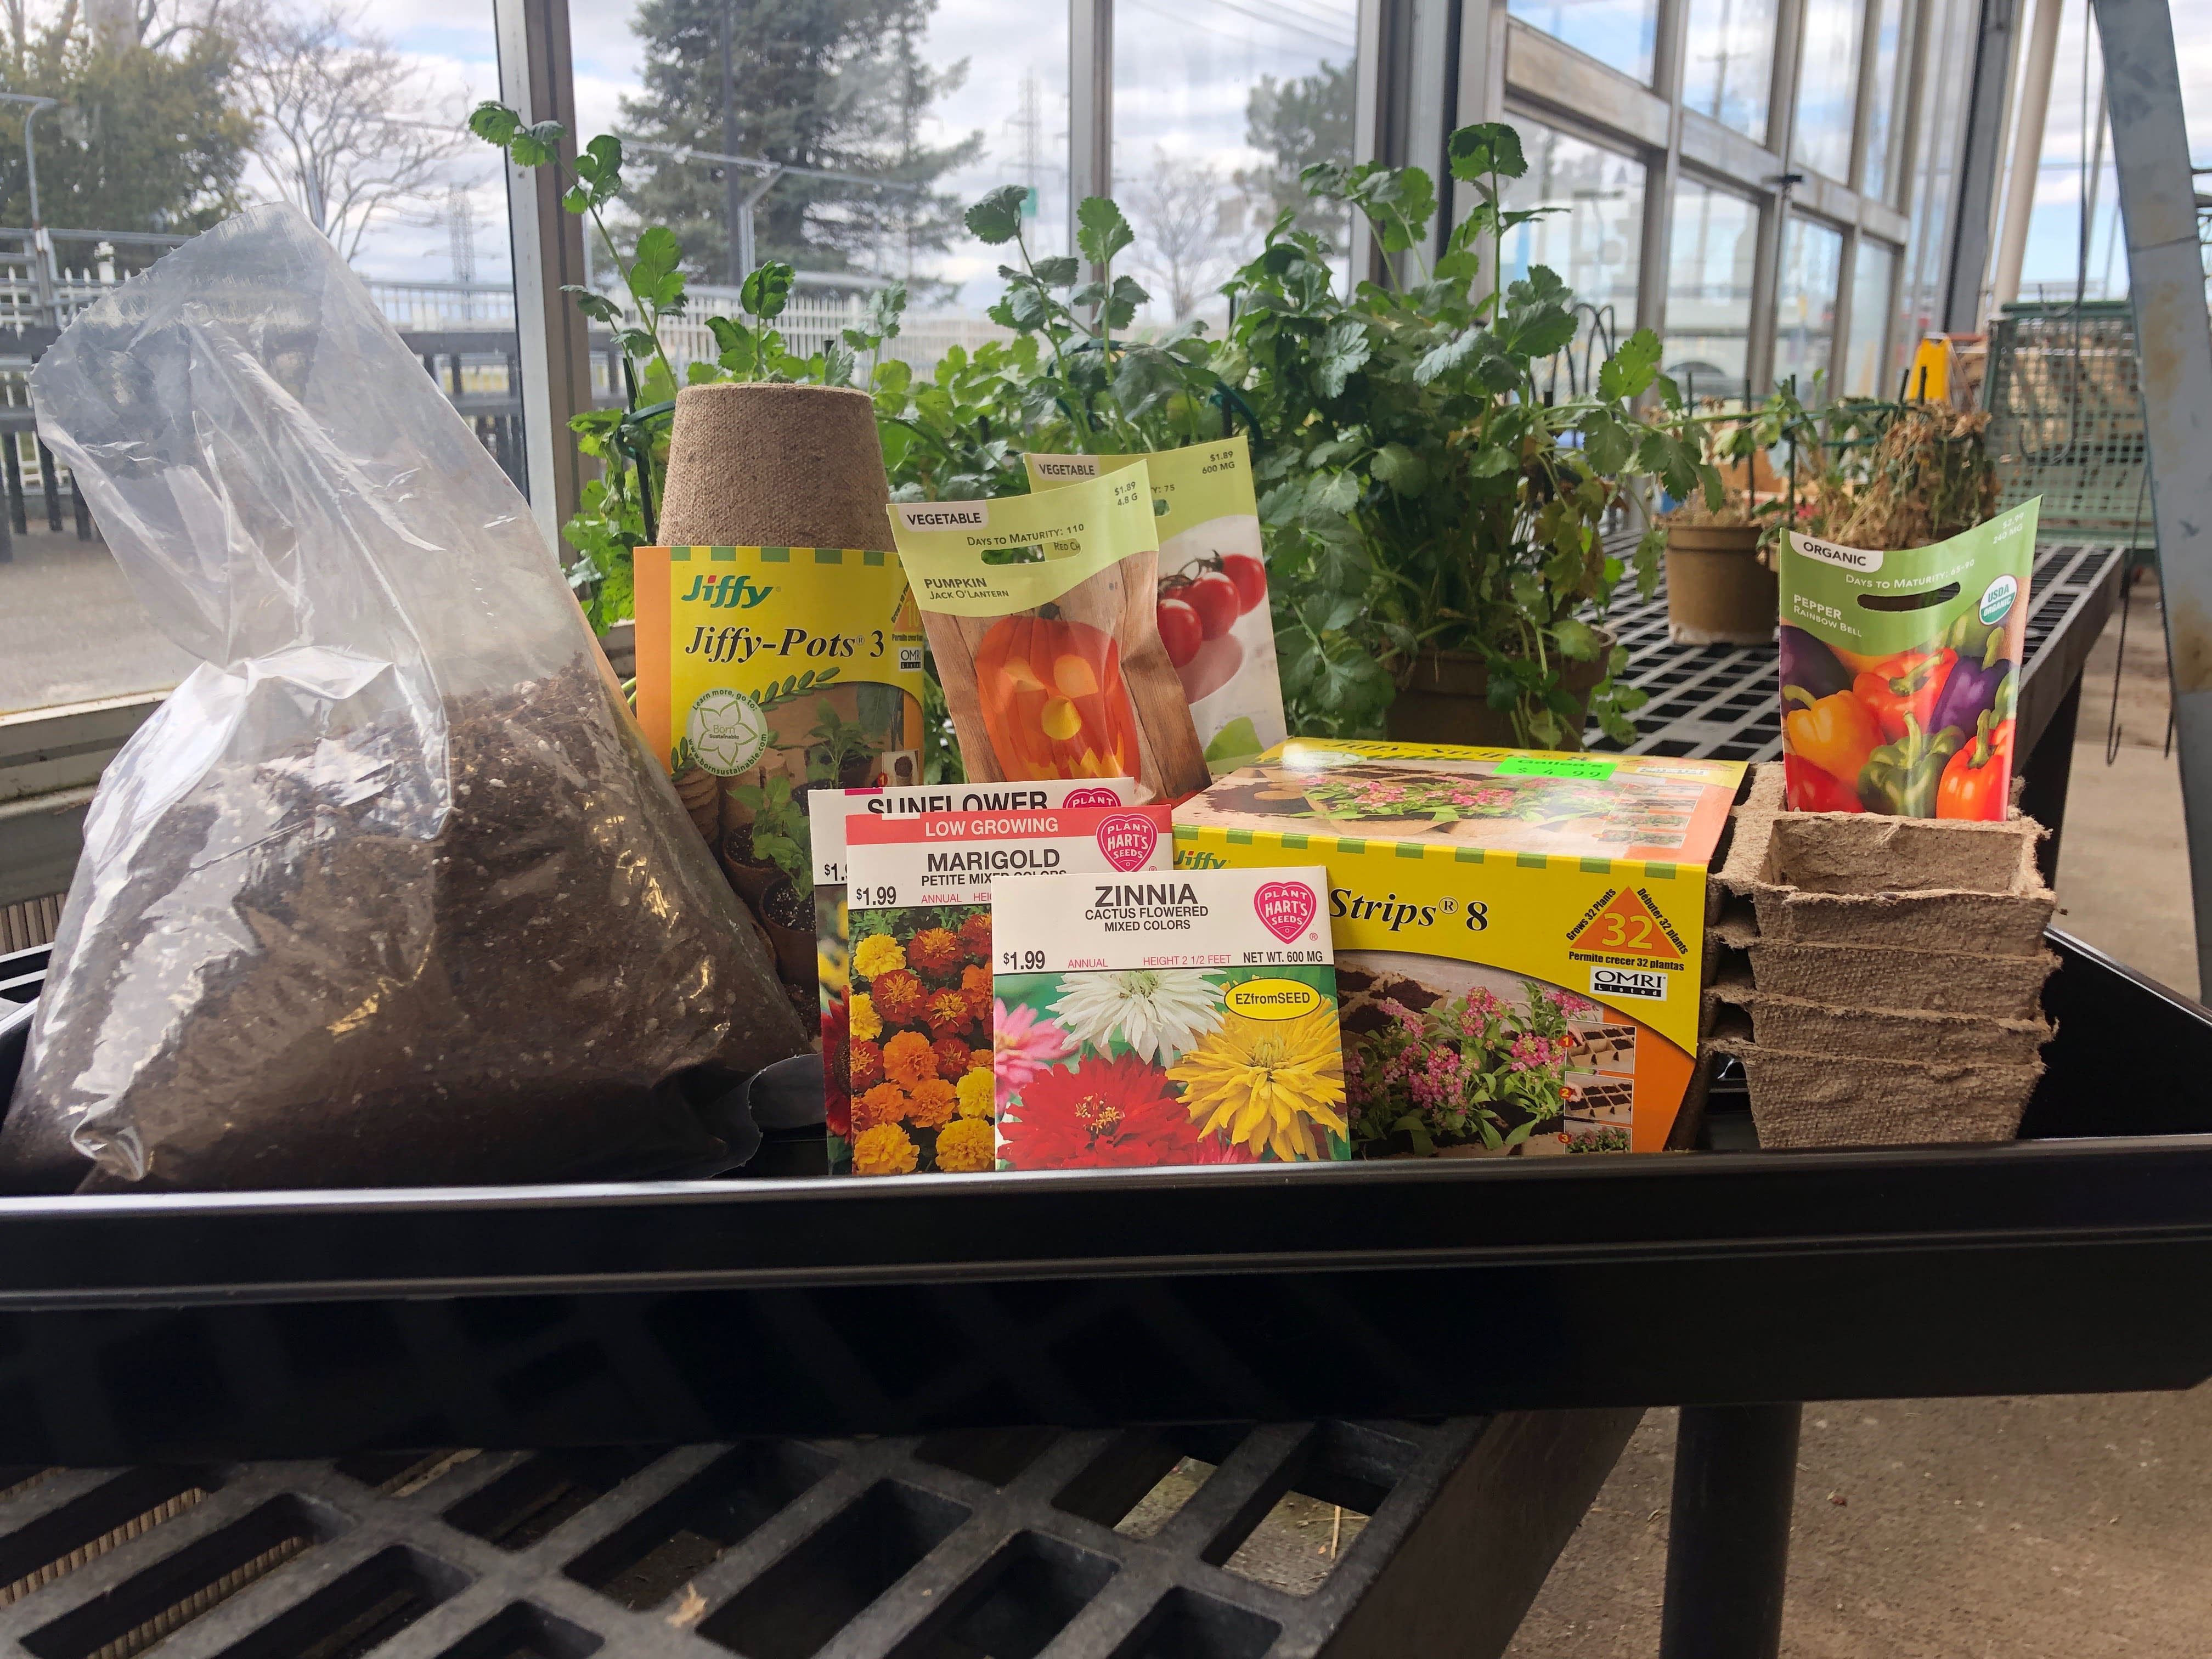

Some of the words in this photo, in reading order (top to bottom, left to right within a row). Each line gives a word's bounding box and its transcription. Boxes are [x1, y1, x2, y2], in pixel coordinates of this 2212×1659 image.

[1210, 451, 1233, 462] $1.89
[1039, 464, 1095, 476] VEGETABLE
[1202, 465, 1218, 475] 600
[1221, 461, 1235, 470] MG
[1115, 481, 1136, 496] $1.89
[1164, 484, 1175, 492] 75
[1118, 496, 1130, 506] 4.8
[1131, 493, 1138, 501] G
[907, 512, 982, 526] VEGETABLE
[2002, 512, 2024, 529] $2.99
[1067, 524, 1085, 534] 110
[1993, 532, 2007, 544] 240
[2009, 523, 2023, 536] MG
[1803, 541, 1866, 566] ORGANIC
[1951, 558, 1974, 575] 65-90
[924, 578, 988, 589] PUMPKIN
[681, 575, 774, 608] Jiffy
[1988, 584, 2009, 602] USDA
[1794, 594, 1842, 620] PEPPER
[1983, 596, 2011, 617] ORGANIC
[870, 630, 884, 657] 3
[692, 692, 713, 710] Learn
[747, 699, 758, 711] to:
[713, 725, 735, 733] Born
[688, 734, 766, 775] www.bornsustainable.com
[880, 775, 884, 785] 1
[1073, 796, 1113, 808] PLANT
[926, 820, 966, 837] LOW
[970, 818, 1058, 836] GROWING
[1107, 823, 1149, 834] PLANT
[1108, 834, 1148, 851] HART'S
[928, 849, 1060, 872] MARIGOLD
[1113, 849, 1143, 859] SEEDS
[922, 874, 965, 886] PETITE
[856, 886, 896, 906] $1.99
[921, 894, 962, 904] ANNUAL
[1095, 883, 1198, 907] ZINNIA
[1265, 889, 1307, 901] PLANT
[1085, 908, 1136, 920] CACTUS
[1139, 906, 1208, 918] FLOWERED
[1265, 901, 1308, 918] HART'S
[1466, 901, 1488, 931] 8
[1566, 918, 1589, 941] Grows
[1584, 909, 1597, 921] 32
[1593, 888, 1616, 912] Plants
[1104, 921, 1140, 932] MIXED
[1143, 919, 1190, 930] COLORS
[1272, 916, 1303, 926] SEEDS
[1637, 888, 1663, 919] Débuter
[1659, 918, 1672, 930] 32
[1666, 929, 1688, 955] plants
[1601, 912, 1653, 949] 32
[1003, 950, 1045, 970] $1.99
[1068, 959, 1108, 969] ANNUAL
[1143, 956, 1180, 966] HEIGHT
[1182, 956, 1188, 965] 2
[1191, 955, 1205, 964] 1/2
[1208, 955, 1232, 964] FEET
[1244, 952, 1263, 963] NET
[1266, 951, 1284, 962] WT.
[1287, 951, 1304, 962] 600
[1307, 951, 1323, 962] MG
[1568, 951, 1604, 963] Permite
[1605, 955, 1635, 966] crecer
[1637, 958, 1648, 967] 32
[1650, 960, 1685, 971] plantas
[1595, 970, 1662, 988] OMRI
[1599, 984, 1657, 996] Listed
[1235, 992, 1310, 1005] EZfromSEED
[1564, 1037, 1569, 1046] 1
